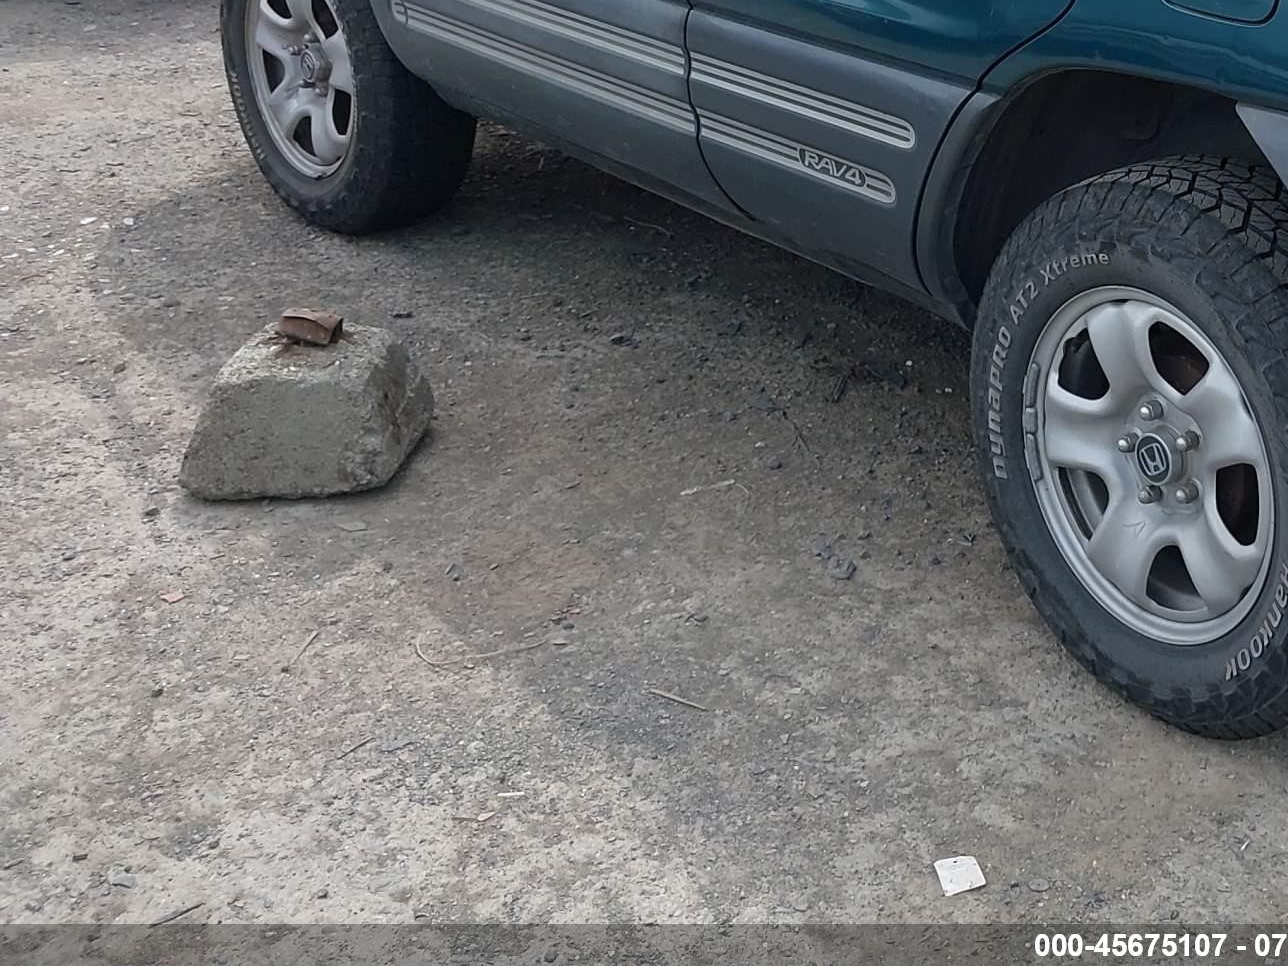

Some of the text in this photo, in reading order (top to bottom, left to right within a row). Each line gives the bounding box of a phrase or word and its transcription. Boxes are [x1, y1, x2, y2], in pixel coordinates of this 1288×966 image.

[804, 150, 862, 185] RAV4
[1009, 280, 1040, 325] AT2
[1040, 250, 1110, 286] Xtreme
